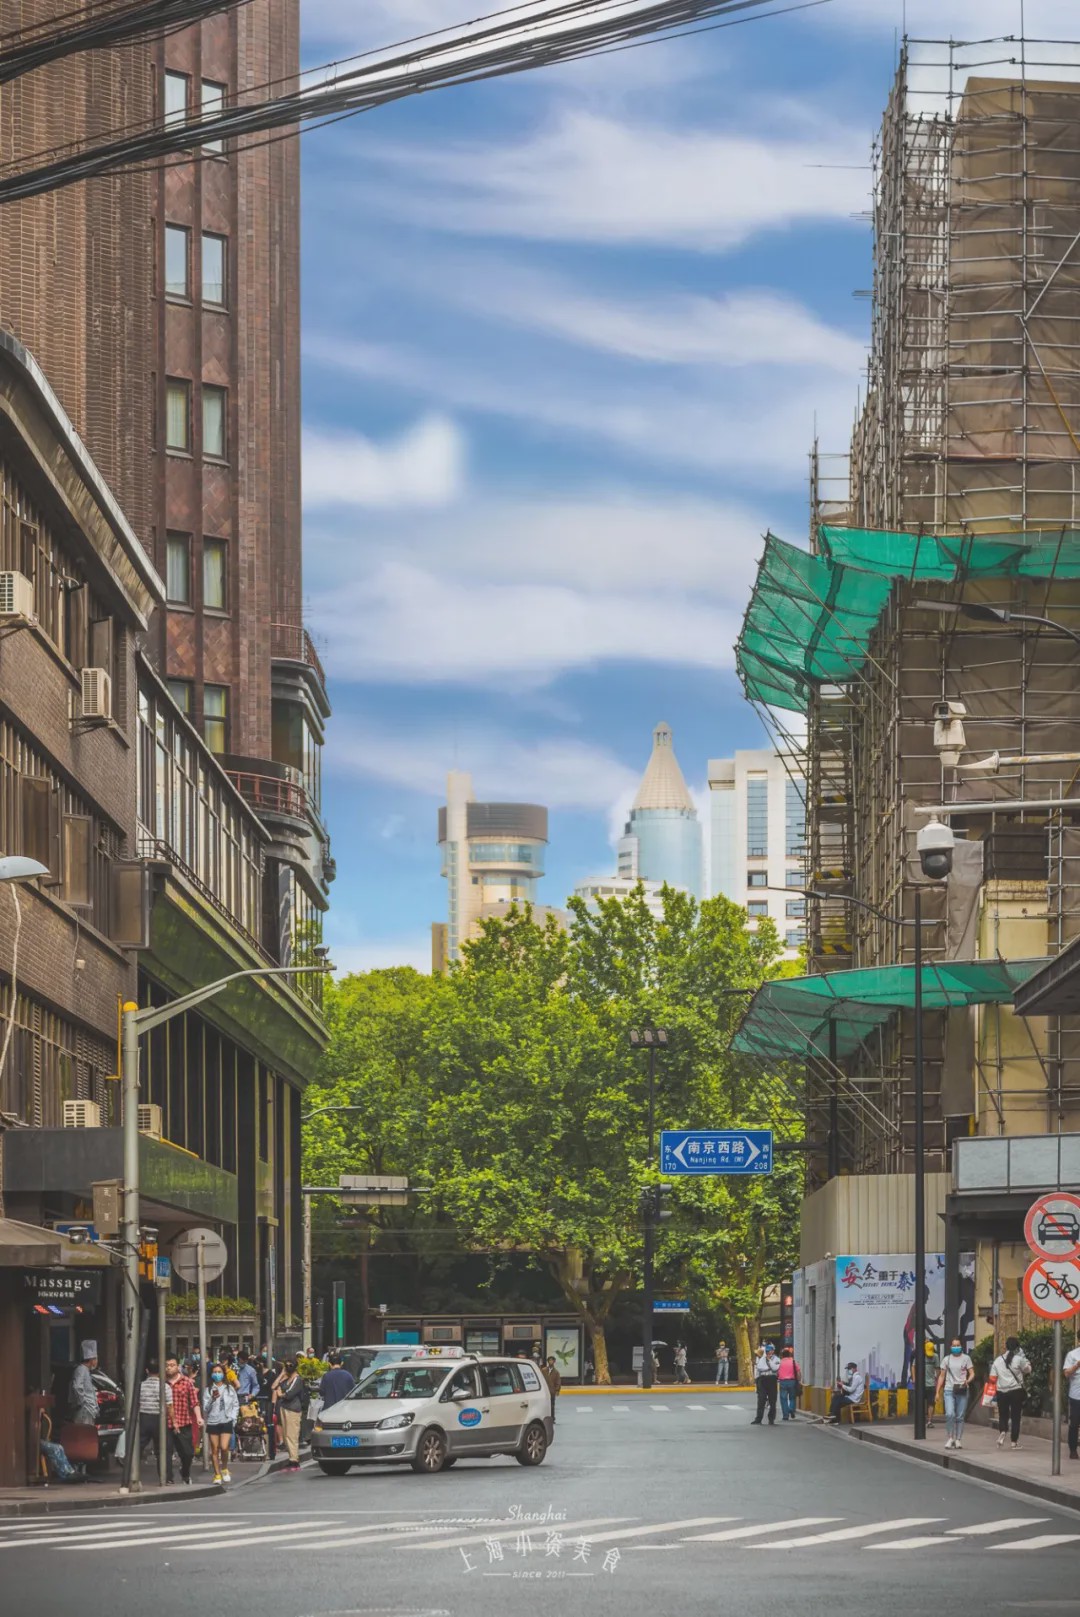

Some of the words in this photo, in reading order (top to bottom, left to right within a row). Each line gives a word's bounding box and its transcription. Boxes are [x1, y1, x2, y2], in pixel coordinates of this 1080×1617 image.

[664, 1145, 672, 1153] 东
[688, 1141, 745, 1154] 南京西路
[762, 1144, 770, 1152] 西
[690, 1156, 716, 1165] Nanjing
[665, 1162, 677, 1170] 170
[754, 1162, 768, 1170] 208
[24, 1275, 91, 1291] Massage
